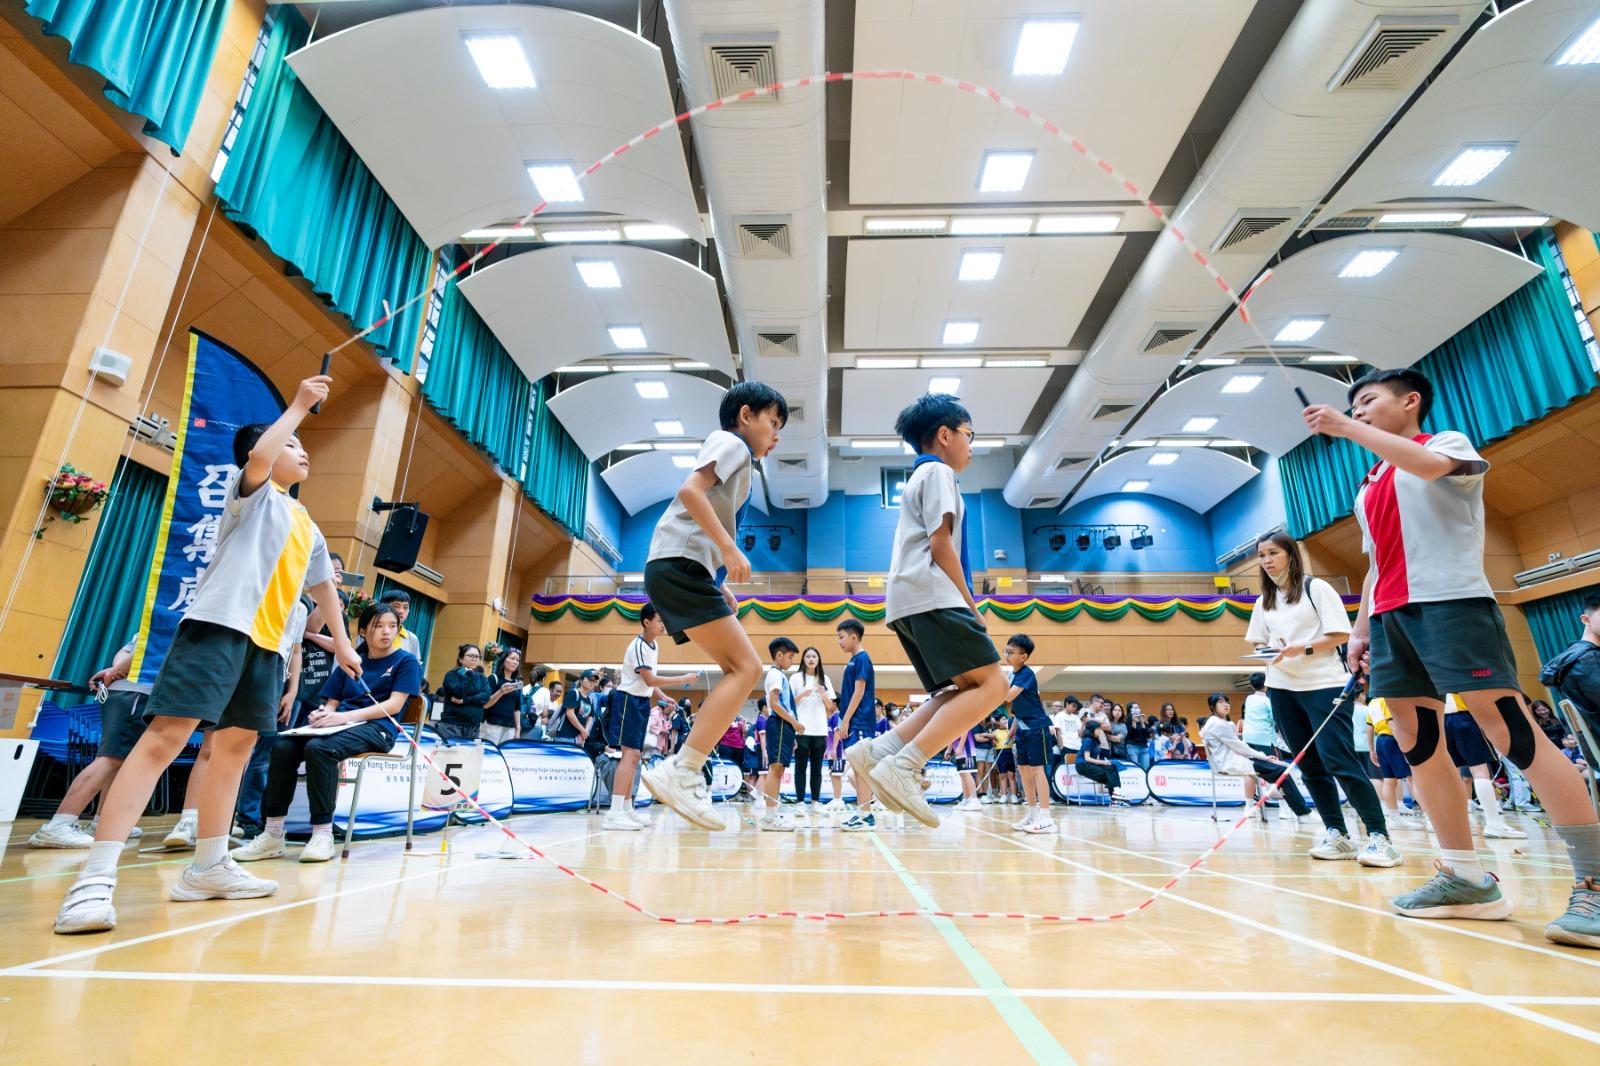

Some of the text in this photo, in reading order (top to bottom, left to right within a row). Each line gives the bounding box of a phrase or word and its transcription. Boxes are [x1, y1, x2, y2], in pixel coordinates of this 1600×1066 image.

[367, 760, 383, 771] Kong
[384, 762, 398, 770] Rope
[440, 763, 463, 796] 5
[724, 774, 729, 786] 1
